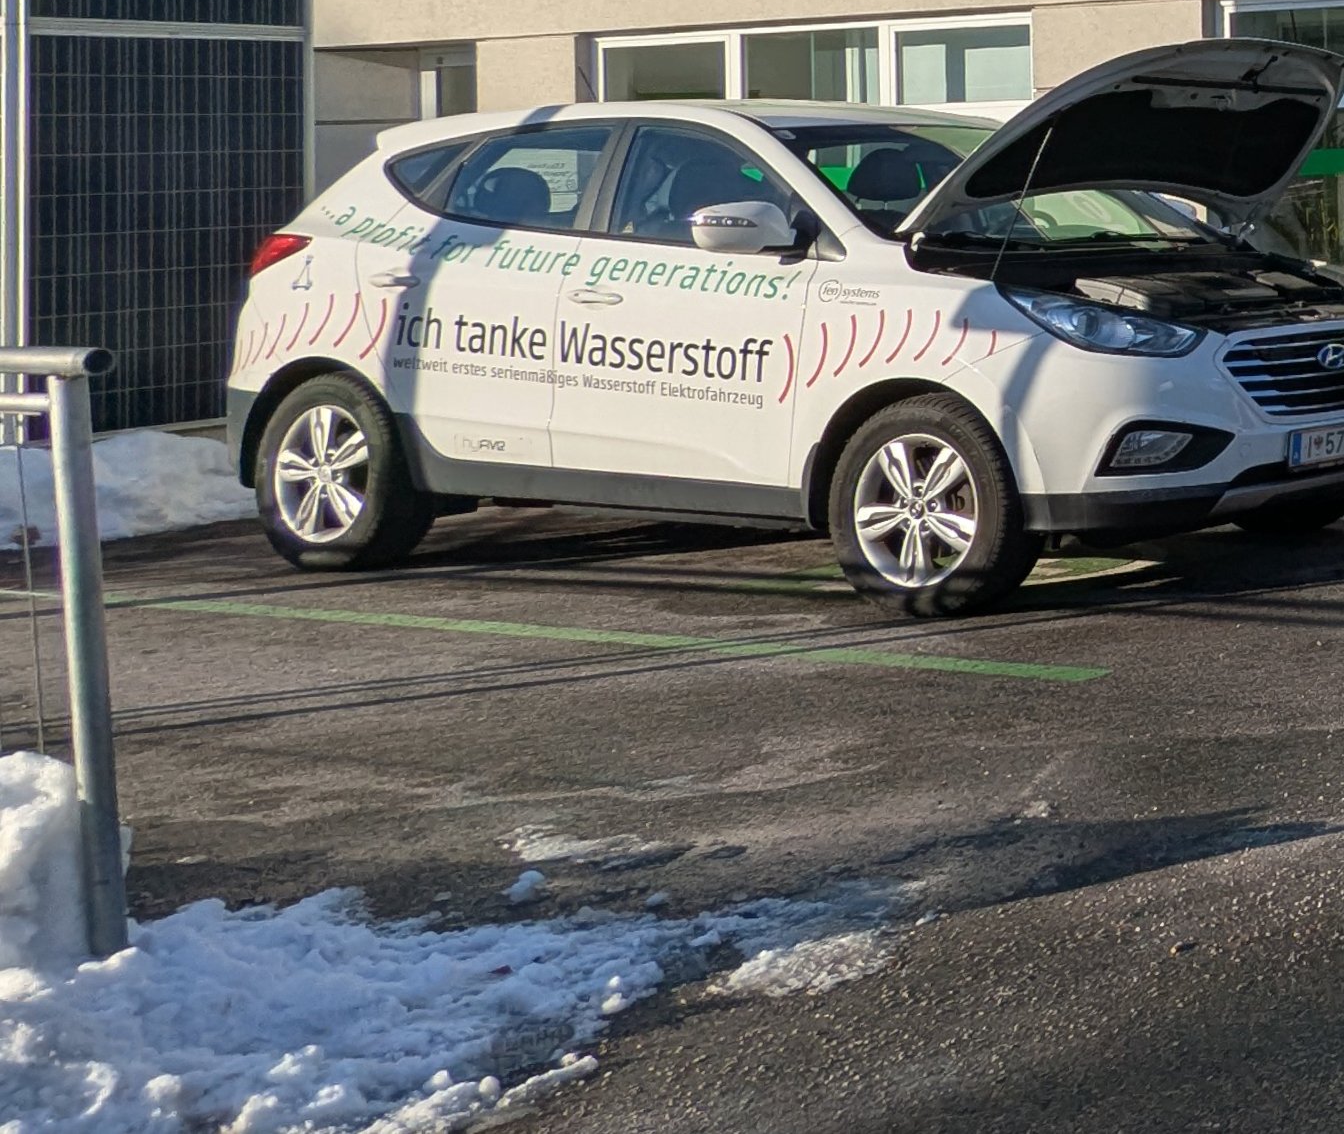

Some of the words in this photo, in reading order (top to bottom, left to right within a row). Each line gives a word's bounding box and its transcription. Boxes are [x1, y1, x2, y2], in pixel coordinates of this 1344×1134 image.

[341, 217, 431, 255] profit
[430, 234, 481, 263] for
[484, 239, 581, 275] future
[585, 255, 803, 301] generations!
[841, 287, 881, 300] systems
[396, 302, 443, 350] ich
[454, 314, 547, 361] tanke
[559, 320, 774, 383] Wasserstoff
[393, 356, 449, 373] weltweit
[452, 363, 487, 377] erstes
[490, 364, 579, 389] serienmäßiges
[582, 374, 657, 395] Wasserstoff
[660, 381, 764, 410] Elektrofahrzeug
